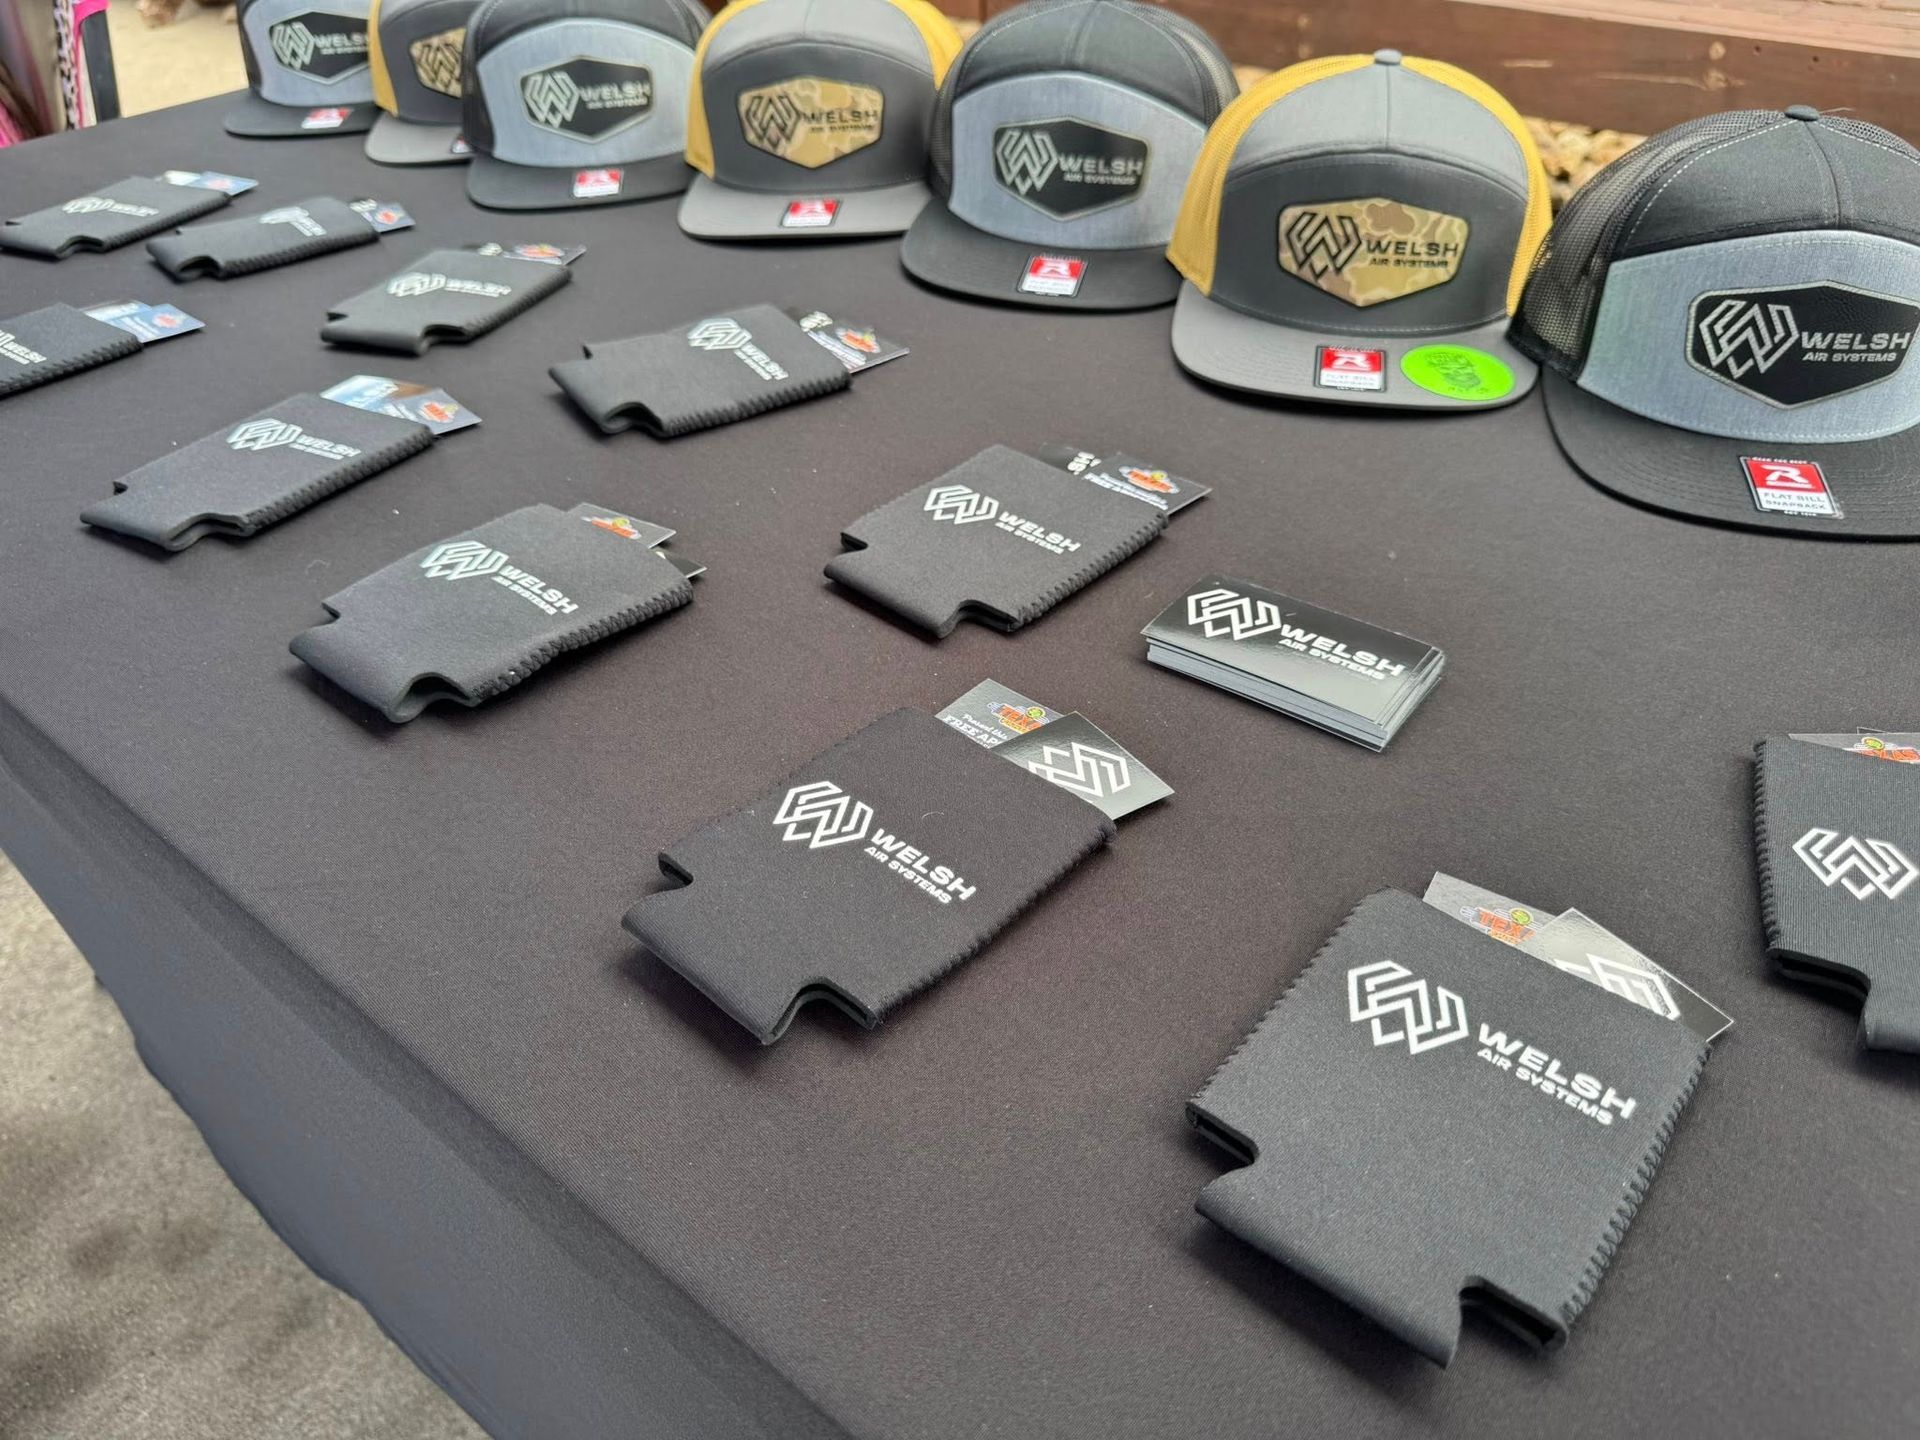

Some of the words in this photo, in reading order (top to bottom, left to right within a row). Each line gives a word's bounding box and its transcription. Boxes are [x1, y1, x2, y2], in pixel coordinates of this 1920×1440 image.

[313, 33, 368, 48] WELS
[580, 82, 652, 101] WELSH
[799, 109, 878, 124] WELSH
[1059, 154, 1143, 176] WELSH
[1366, 240, 1459, 257] WELSH
[1800, 331, 1912, 351] WELSH
[1802, 352, 1829, 362] AIR
[1831, 352, 1897, 363] SYSTEMS
[998, 511, 1082, 552] WELSH
[498, 564, 579, 615] WELSH
[1277, 637, 1306, 653] AIR
[1308, 645, 1387, 681] SYSTEMS
[1279, 624, 1407, 678] WELSH
[943, 713, 983, 736] FREE
[863, 846, 889, 864] AIR
[888, 860, 952, 904] SYSTEMS
[870, 828, 977, 901] WELSH
[1476, 1048, 1512, 1073] AIR
[1515, 1066, 1614, 1126] SYSTEMS
[1477, 1022, 1637, 1121] WELSH
